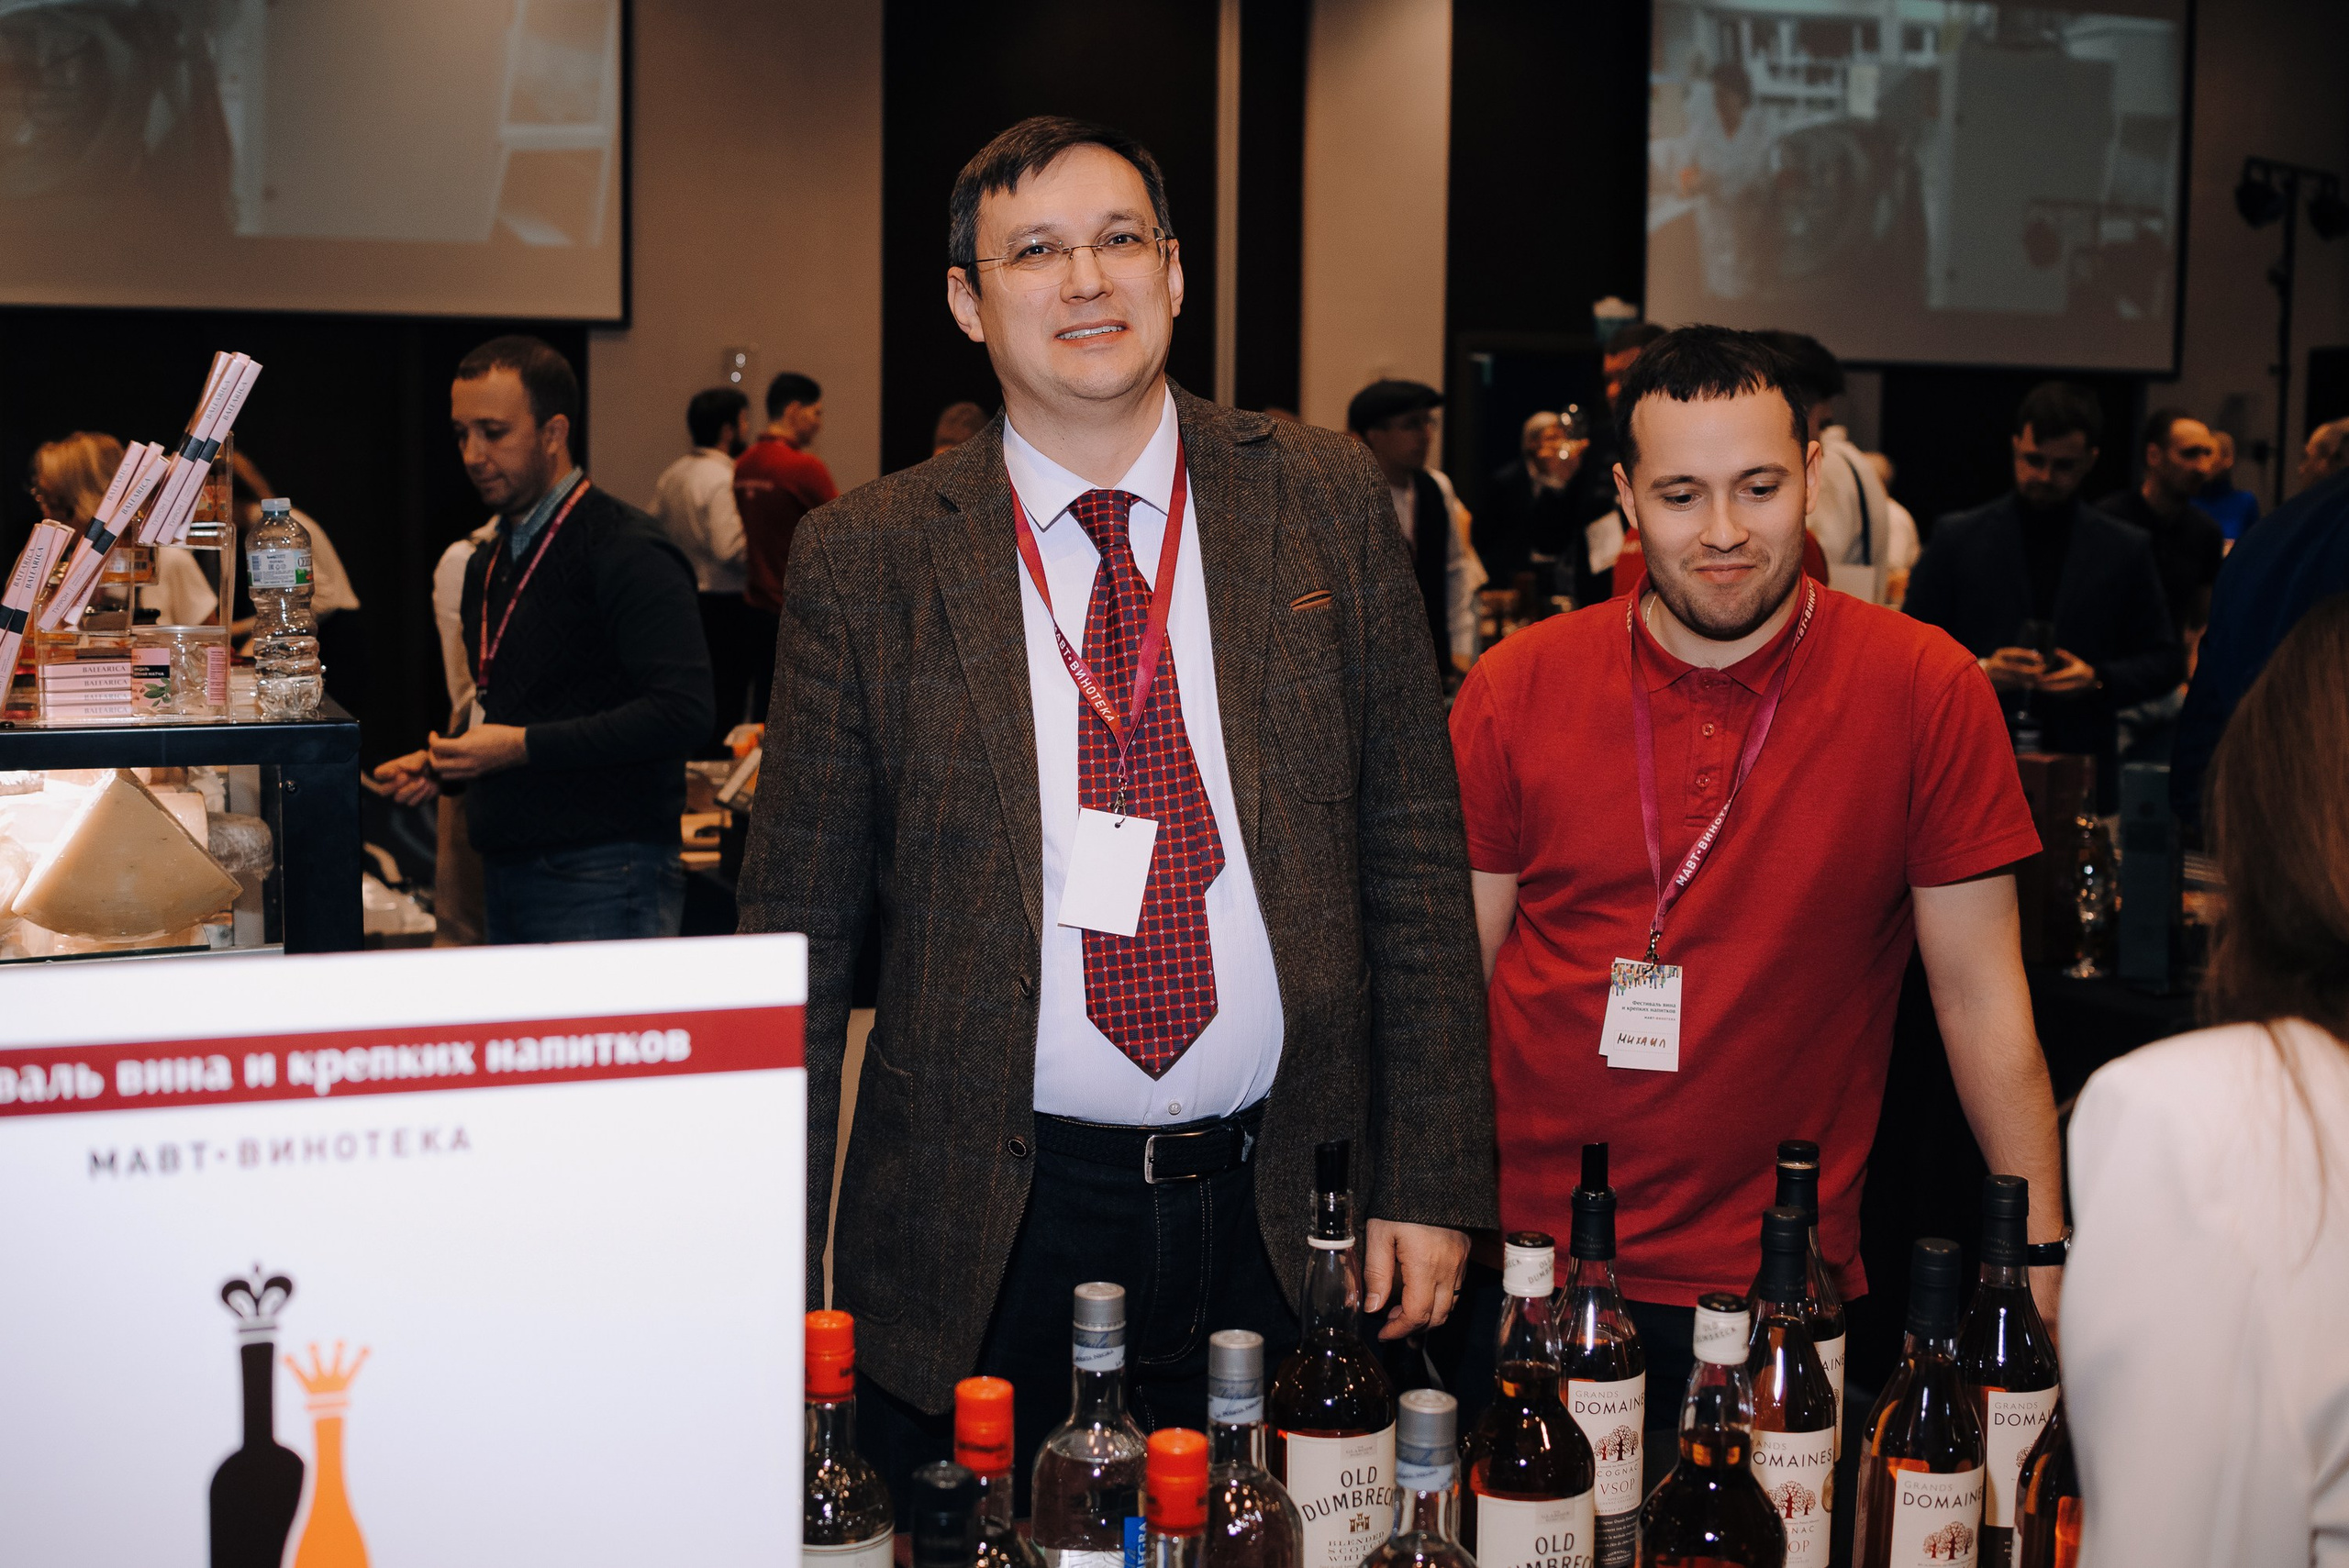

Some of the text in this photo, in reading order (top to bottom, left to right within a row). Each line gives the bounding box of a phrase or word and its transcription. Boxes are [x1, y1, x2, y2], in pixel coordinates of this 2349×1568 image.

[82, 665, 127, 673] BALEARICA
[116, 1054, 233, 1097] вина
[244, 1051, 276, 1089] и
[287, 1041, 476, 1097] крепких
[484, 1029, 691, 1073] напитков
[1575, 1390, 1619, 1398] GRANDS
[1575, 1392, 1644, 1415] DOMAINE
[1994, 1401, 2038, 1410] GRANDS
[1994, 1409, 2053, 1427] DOMAI
[1754, 1440, 1787, 1451] ANDS
[1753, 1448, 1832, 1468] OMAINES
[1341, 1466, 1377, 1488] OLD
[1597, 1463, 1639, 1477] COGNAC
[1600, 1477, 1635, 1495] VSOP
[1904, 1480, 1954, 1492] GRANDS
[1903, 1485, 1983, 1509] DOMAINE
[1791, 1526, 1815, 1534] NAC
[1329, 1531, 1385, 1546] BLENDED
[1535, 1532, 1575, 1555] OLD
[1328, 1540, 1384, 1553] SCOTCH
[1787, 1540, 1810, 1553] OP
